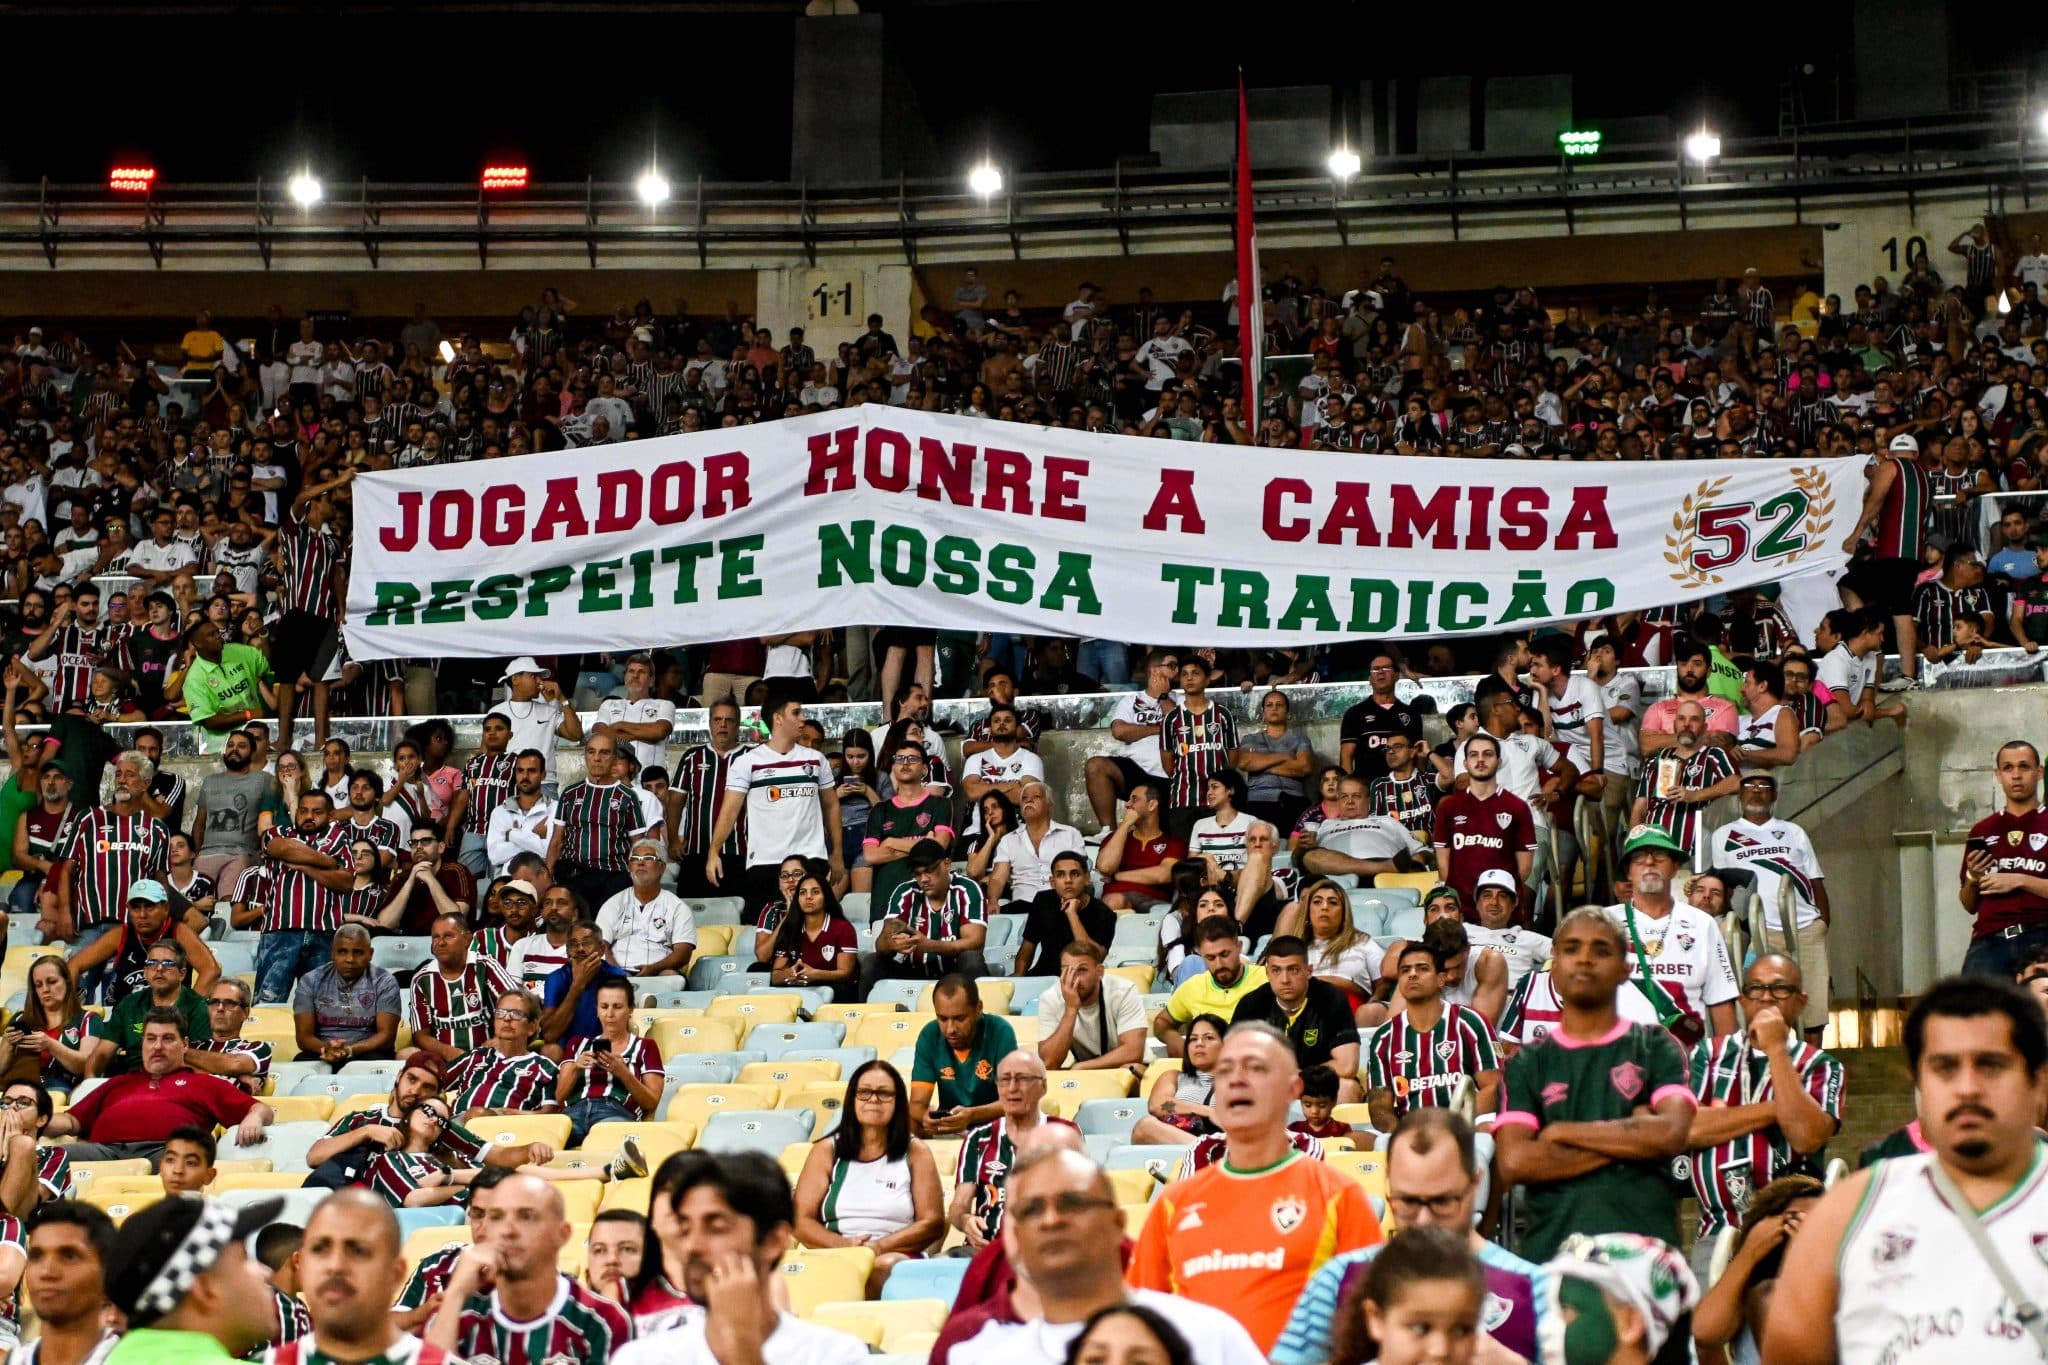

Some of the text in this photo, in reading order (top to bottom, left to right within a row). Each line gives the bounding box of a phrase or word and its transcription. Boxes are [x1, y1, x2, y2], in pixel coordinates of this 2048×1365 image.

[1881, 235, 1928, 272] 10
[812, 282, 852, 317] 11
[379, 426, 1619, 553] JOGADOR HONRE A CAMISA
[1690, 486, 1812, 573] 52
[365, 533, 765, 627] RESPEITE
[817, 519, 1102, 616] NOSSA
[1189, 743, 1222, 754] BETANO
[1399, 803, 1432, 821] BETANO
[111, 841, 151, 855] BETANO
[1464, 834, 1504, 849] BETANO
[1736, 846, 1792, 861] SUPERBET
[1410, 1072, 1462, 1093] BETANO
